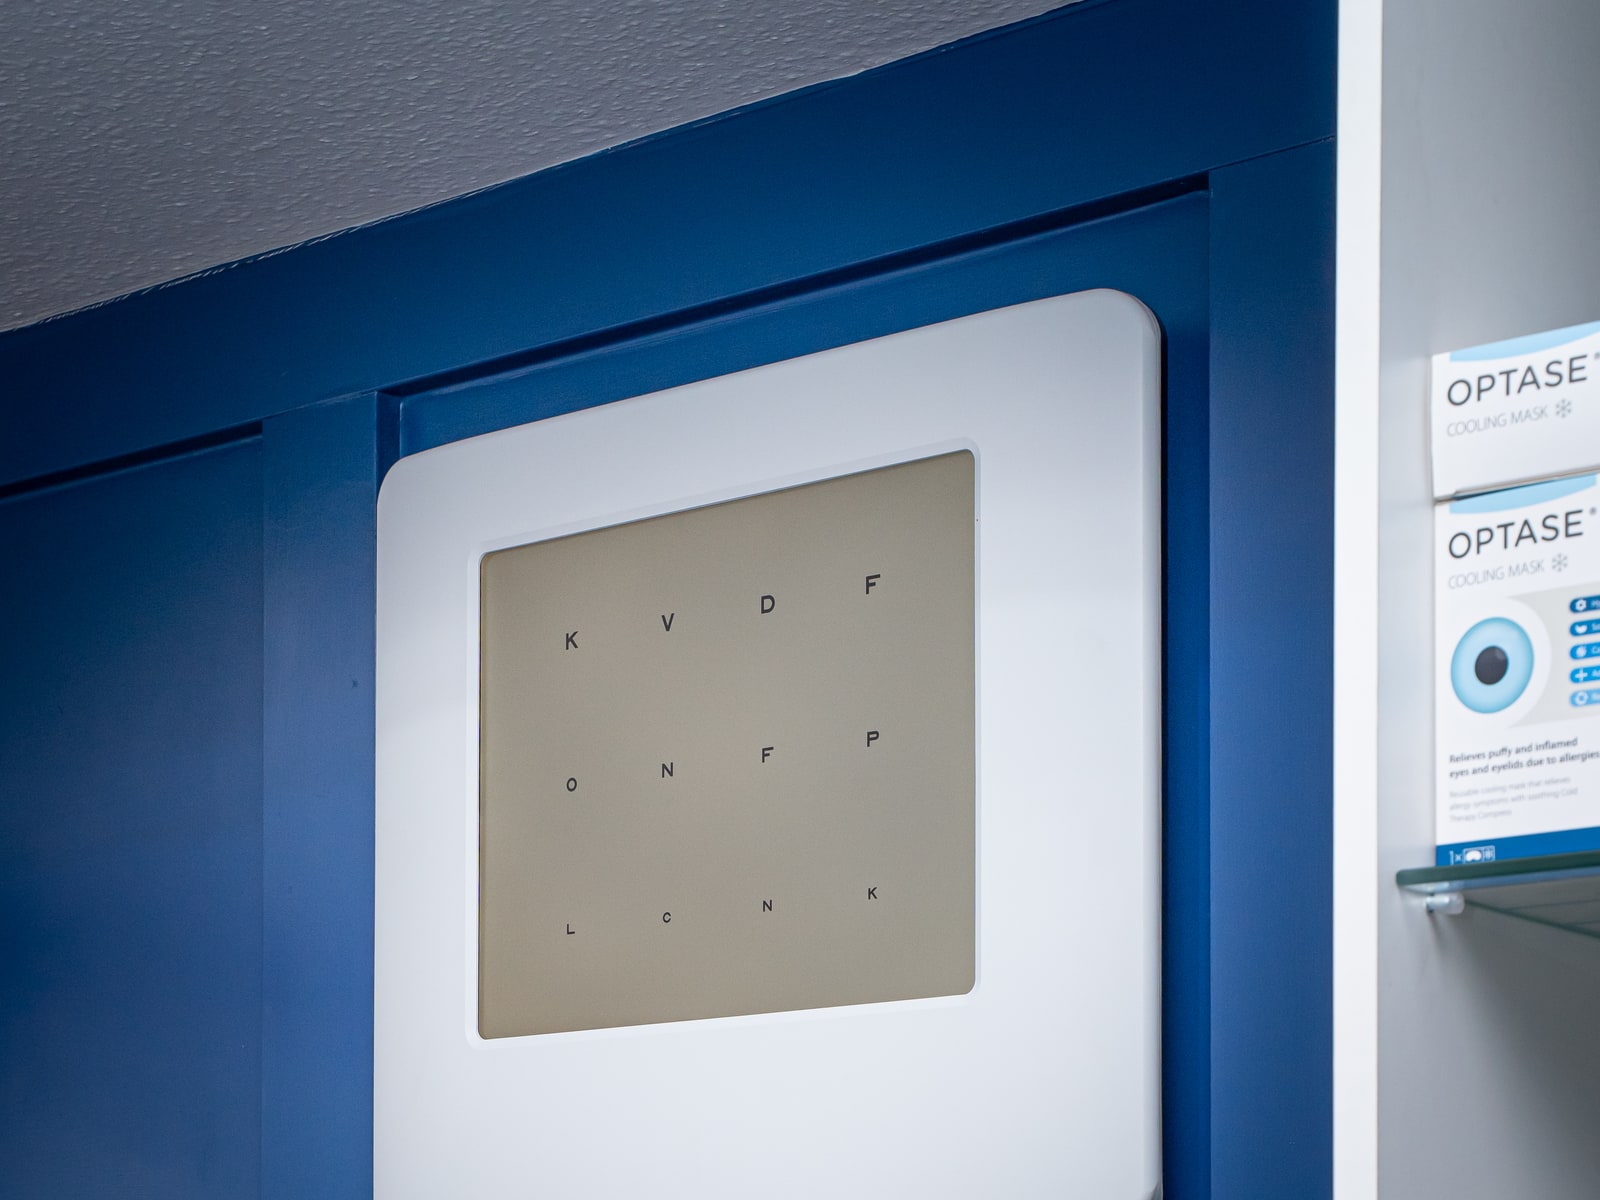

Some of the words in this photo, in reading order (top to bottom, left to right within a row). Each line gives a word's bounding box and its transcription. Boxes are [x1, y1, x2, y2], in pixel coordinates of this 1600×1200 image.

[1447, 355, 1588, 406] OPTASE
[1447, 413, 1507, 437] COOLING
[1511, 405, 1549, 424] MASK
[1448, 509, 1584, 559] OPTASE
[1448, 566, 1505, 590] COOLING
[1508, 559, 1545, 578] MASK
[565, 630, 579, 651] K
[661, 612, 675, 632] V
[760, 594, 776, 615] D
[865, 573, 881, 595] F
[661, 761, 674, 779] N
[761, 746, 775, 764] F
[866, 730, 880, 748] P
[1449, 753, 1486, 764] Relieves
[1488, 747, 1513, 760] puffy
[1515, 743, 1533, 754] and
[1535, 737, 1578, 751] inflamed
[1449, 767, 1469, 779] eyes
[1472, 764, 1489, 775] and
[1491, 760, 1524, 774] eyelids
[1526, 757, 1545, 768] due
[1547, 755, 1557, 765] to
[566, 923, 576, 936] L
[662, 911, 672, 924] C
[762, 899, 773, 913] N
[867, 886, 878, 901] K
